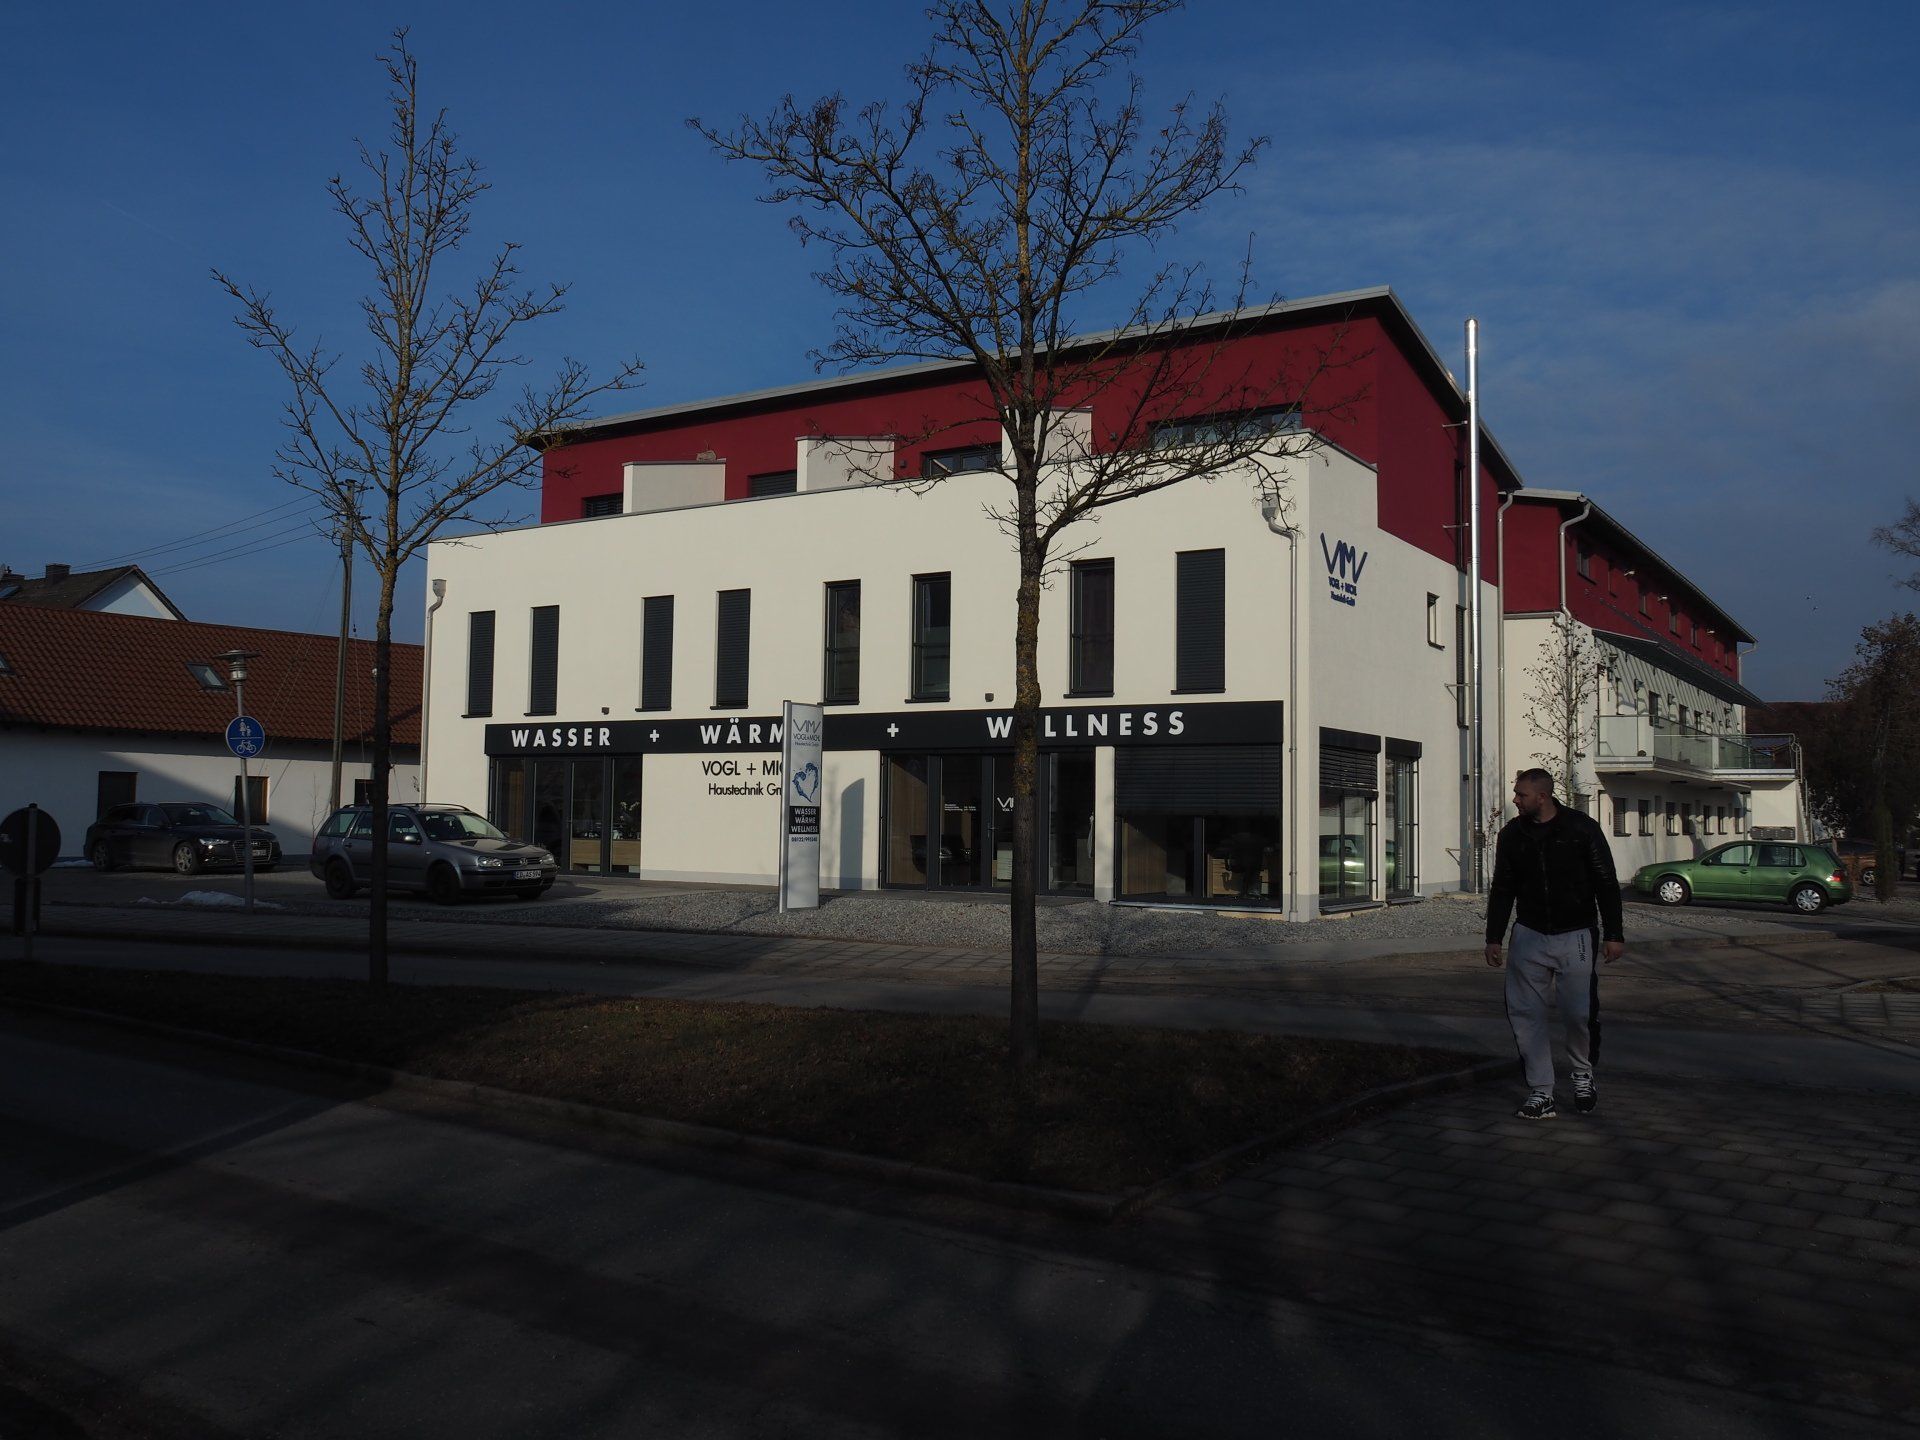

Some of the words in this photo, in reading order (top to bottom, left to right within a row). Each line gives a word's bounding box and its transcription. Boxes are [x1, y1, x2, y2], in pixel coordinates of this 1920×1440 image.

[511, 727, 612, 748] WASSER
[700, 717, 784, 745] WÄRM
[986, 711, 1186, 739] WLLNESS
[702, 760, 741, 776] VOGL
[708, 781, 764, 796] Haustechnik
[794, 807, 817, 815] WASSER
[791, 825, 818, 833] WELLNESS
